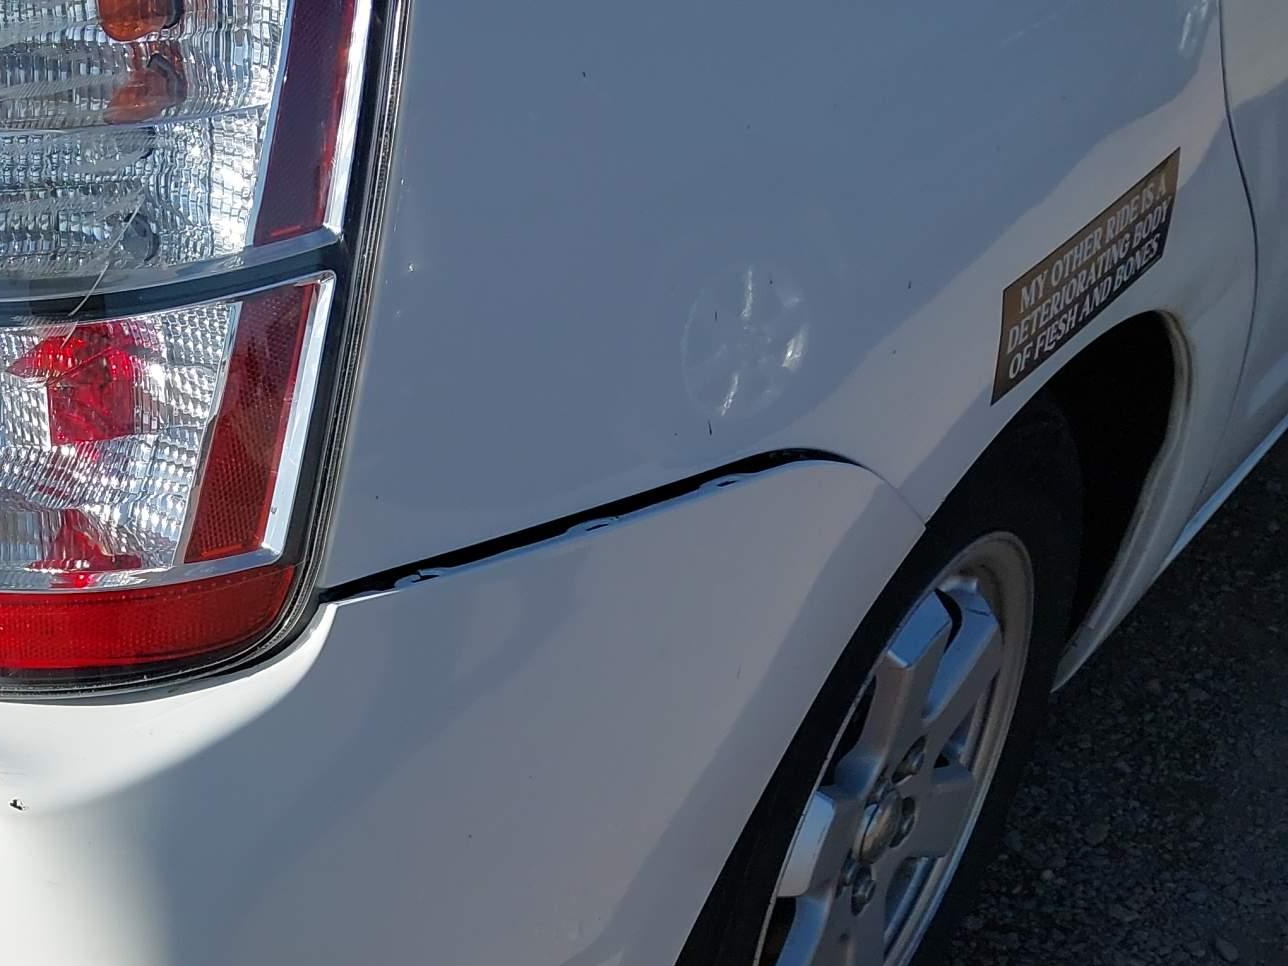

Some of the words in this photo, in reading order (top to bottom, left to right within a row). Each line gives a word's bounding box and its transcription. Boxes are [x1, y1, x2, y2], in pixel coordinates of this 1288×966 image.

[1007, 233, 1130, 355] DETERIORATING
[1132, 196, 1173, 249] BODY
[1008, 343, 1036, 379] OF
[1034, 307, 1079, 361] FLESH
[1079, 279, 1113, 322] AND
[1113, 233, 1161, 293] BONES
[1020, 270, 1049, 313] MY
[1051, 228, 1103, 284] OTHER
[1106, 203, 1140, 243] RIDE
[1141, 180, 1155, 215] IS
[1158, 172, 1167, 196] A
